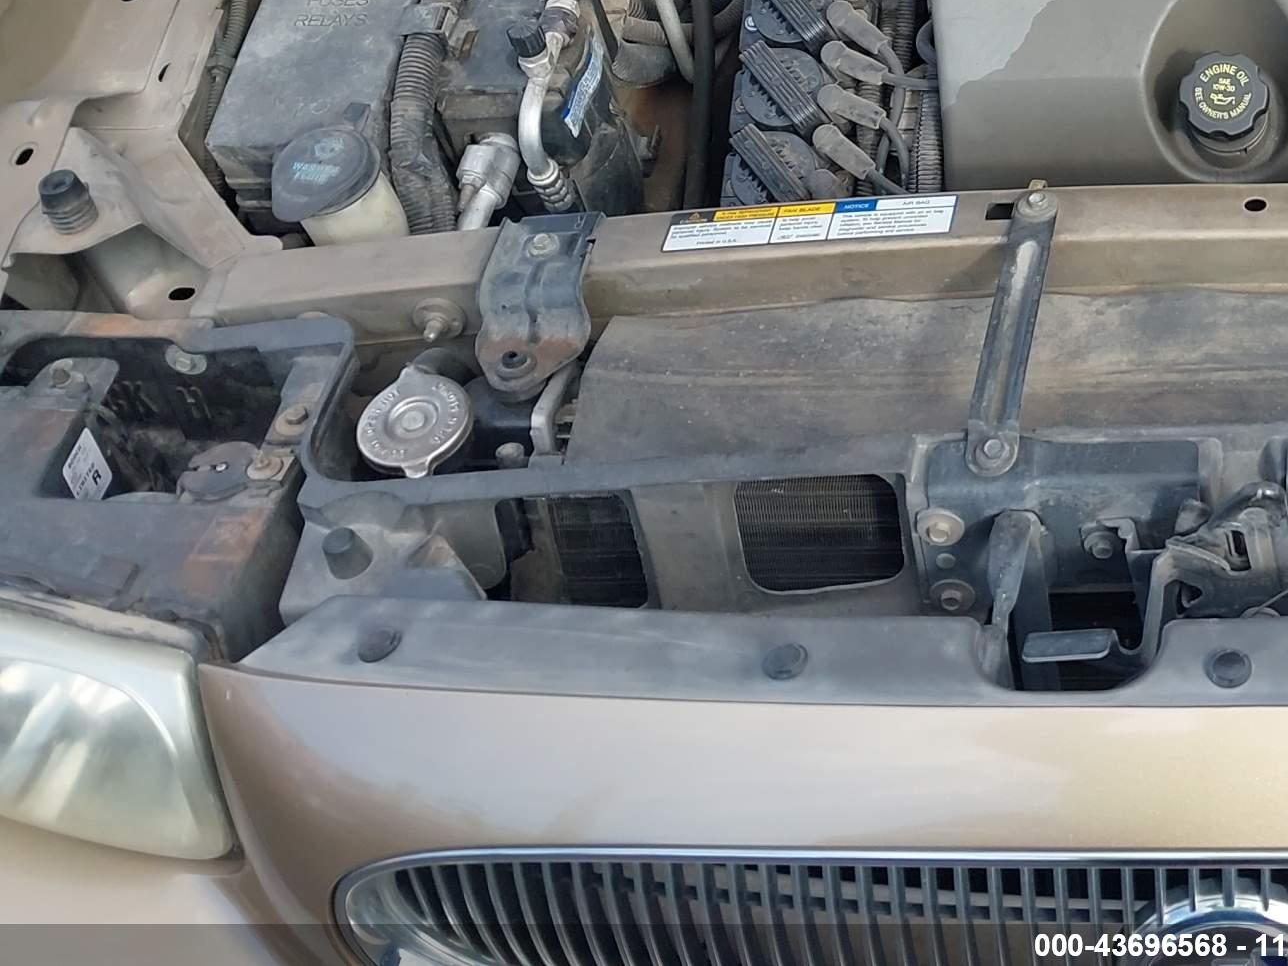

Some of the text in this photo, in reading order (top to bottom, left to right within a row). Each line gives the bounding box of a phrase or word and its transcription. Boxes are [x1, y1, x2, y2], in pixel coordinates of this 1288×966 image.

[294, 13, 369, 27] RELAYS
[1199, 63, 1250, 87] ENGINE OIL
[1194, 87, 1203, 103] SEE
[1229, 92, 1252, 117] MANUAL
